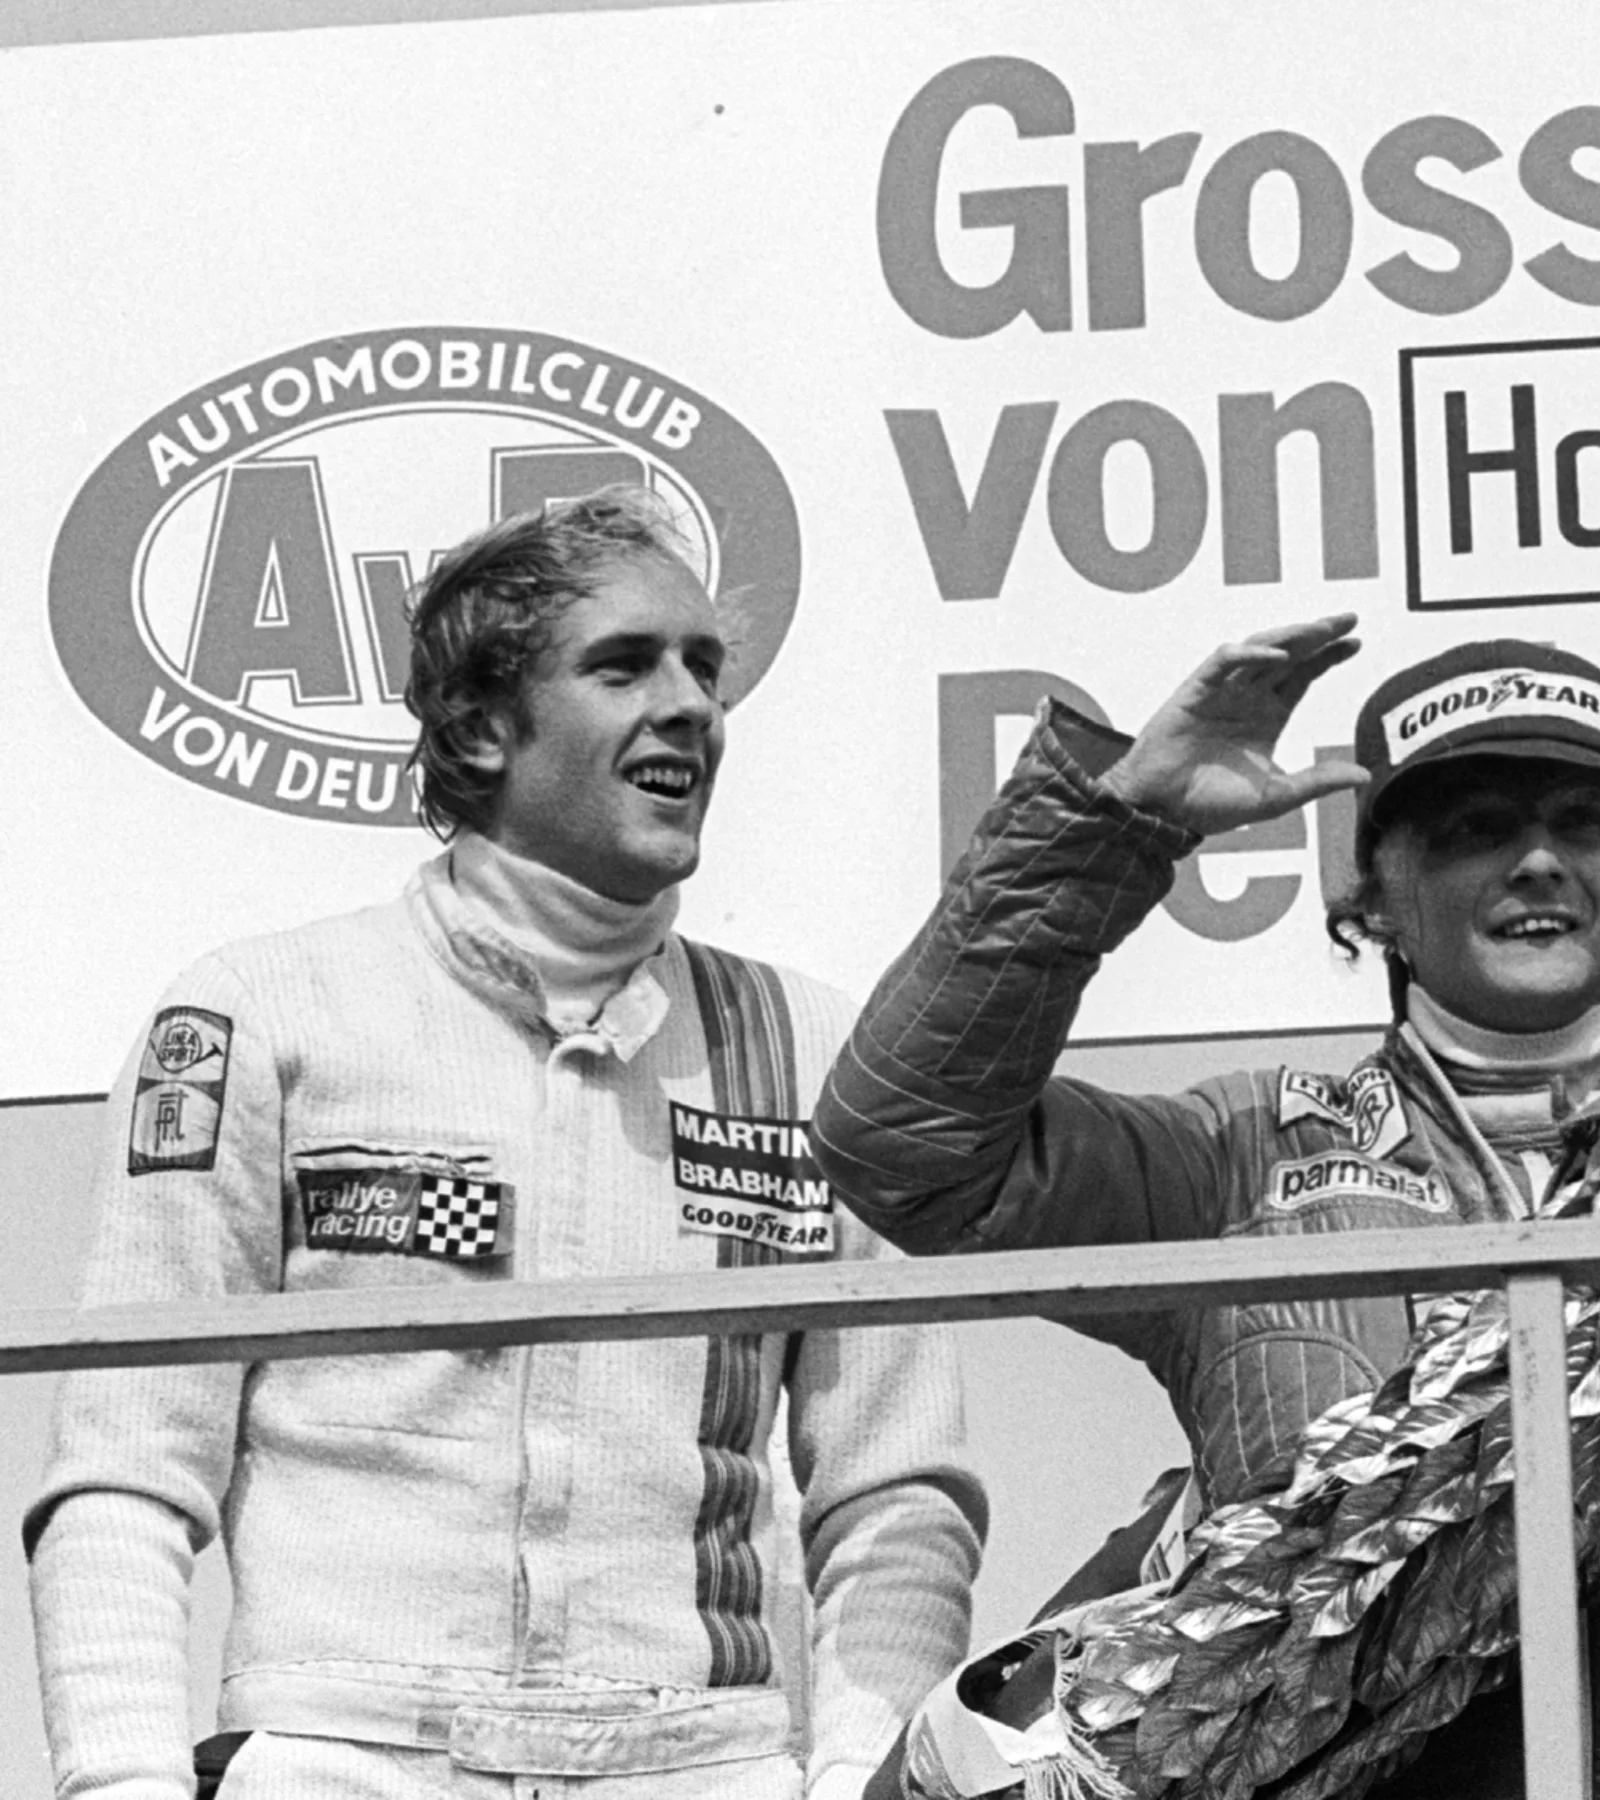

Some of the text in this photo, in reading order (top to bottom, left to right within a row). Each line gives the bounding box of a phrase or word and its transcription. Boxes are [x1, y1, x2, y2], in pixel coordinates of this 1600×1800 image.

[145, 338, 704, 488] AUTOMOBILCLUB
[882, 380, 1381, 603] von
[138, 686, 269, 788] VON
[308, 1181, 398, 1214] rallye
[677, 1156, 829, 1207] BRABHAM
[1281, 1158, 1441, 1205] parmalat
[310, 1209, 411, 1243] racing
